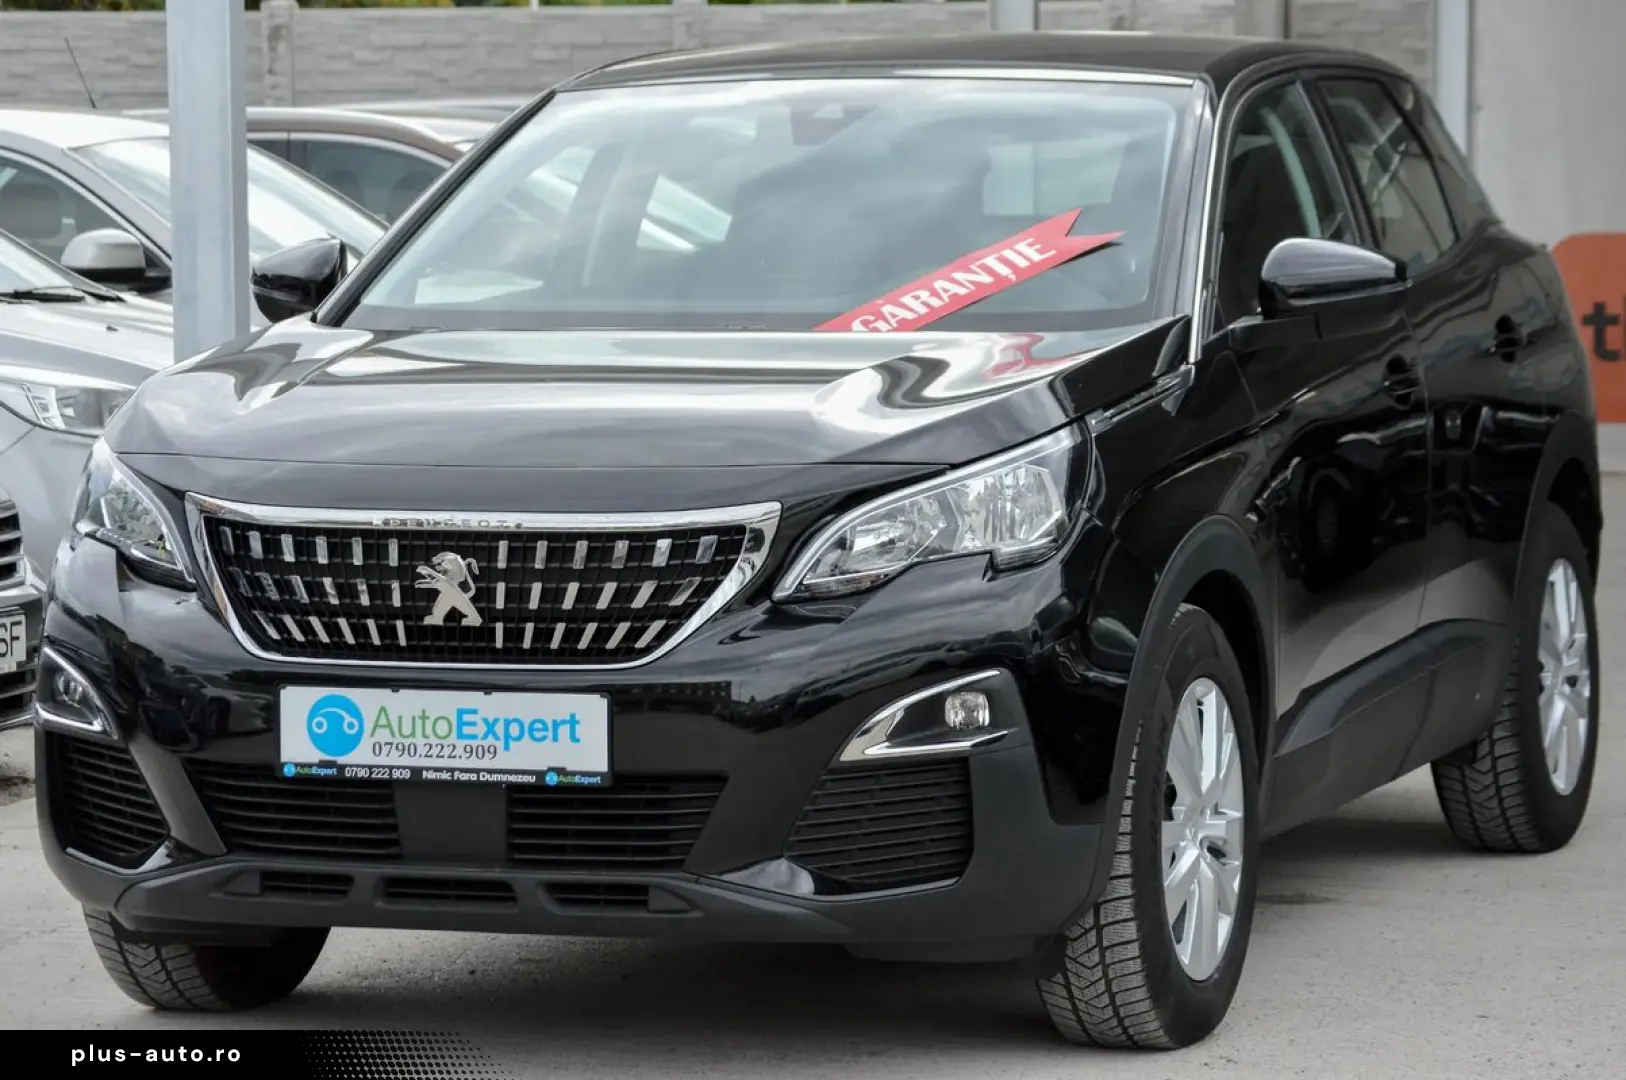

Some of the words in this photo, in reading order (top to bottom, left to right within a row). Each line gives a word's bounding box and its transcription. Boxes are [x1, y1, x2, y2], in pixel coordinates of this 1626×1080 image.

[1583, 295, 1626, 362] t
[369, 706, 581, 752] AutoExpert
[372, 742, 497, 760] 0790.222.909
[296, 766, 338, 777] AutoExpert
[345, 767, 369, 778] 0790
[371, 769, 390, 778] 222
[392, 769, 411, 780] 909
[422, 770, 452, 780] Nimic
[454, 771, 478, 781] Fara
[559, 775, 602, 786] AutoExpert
